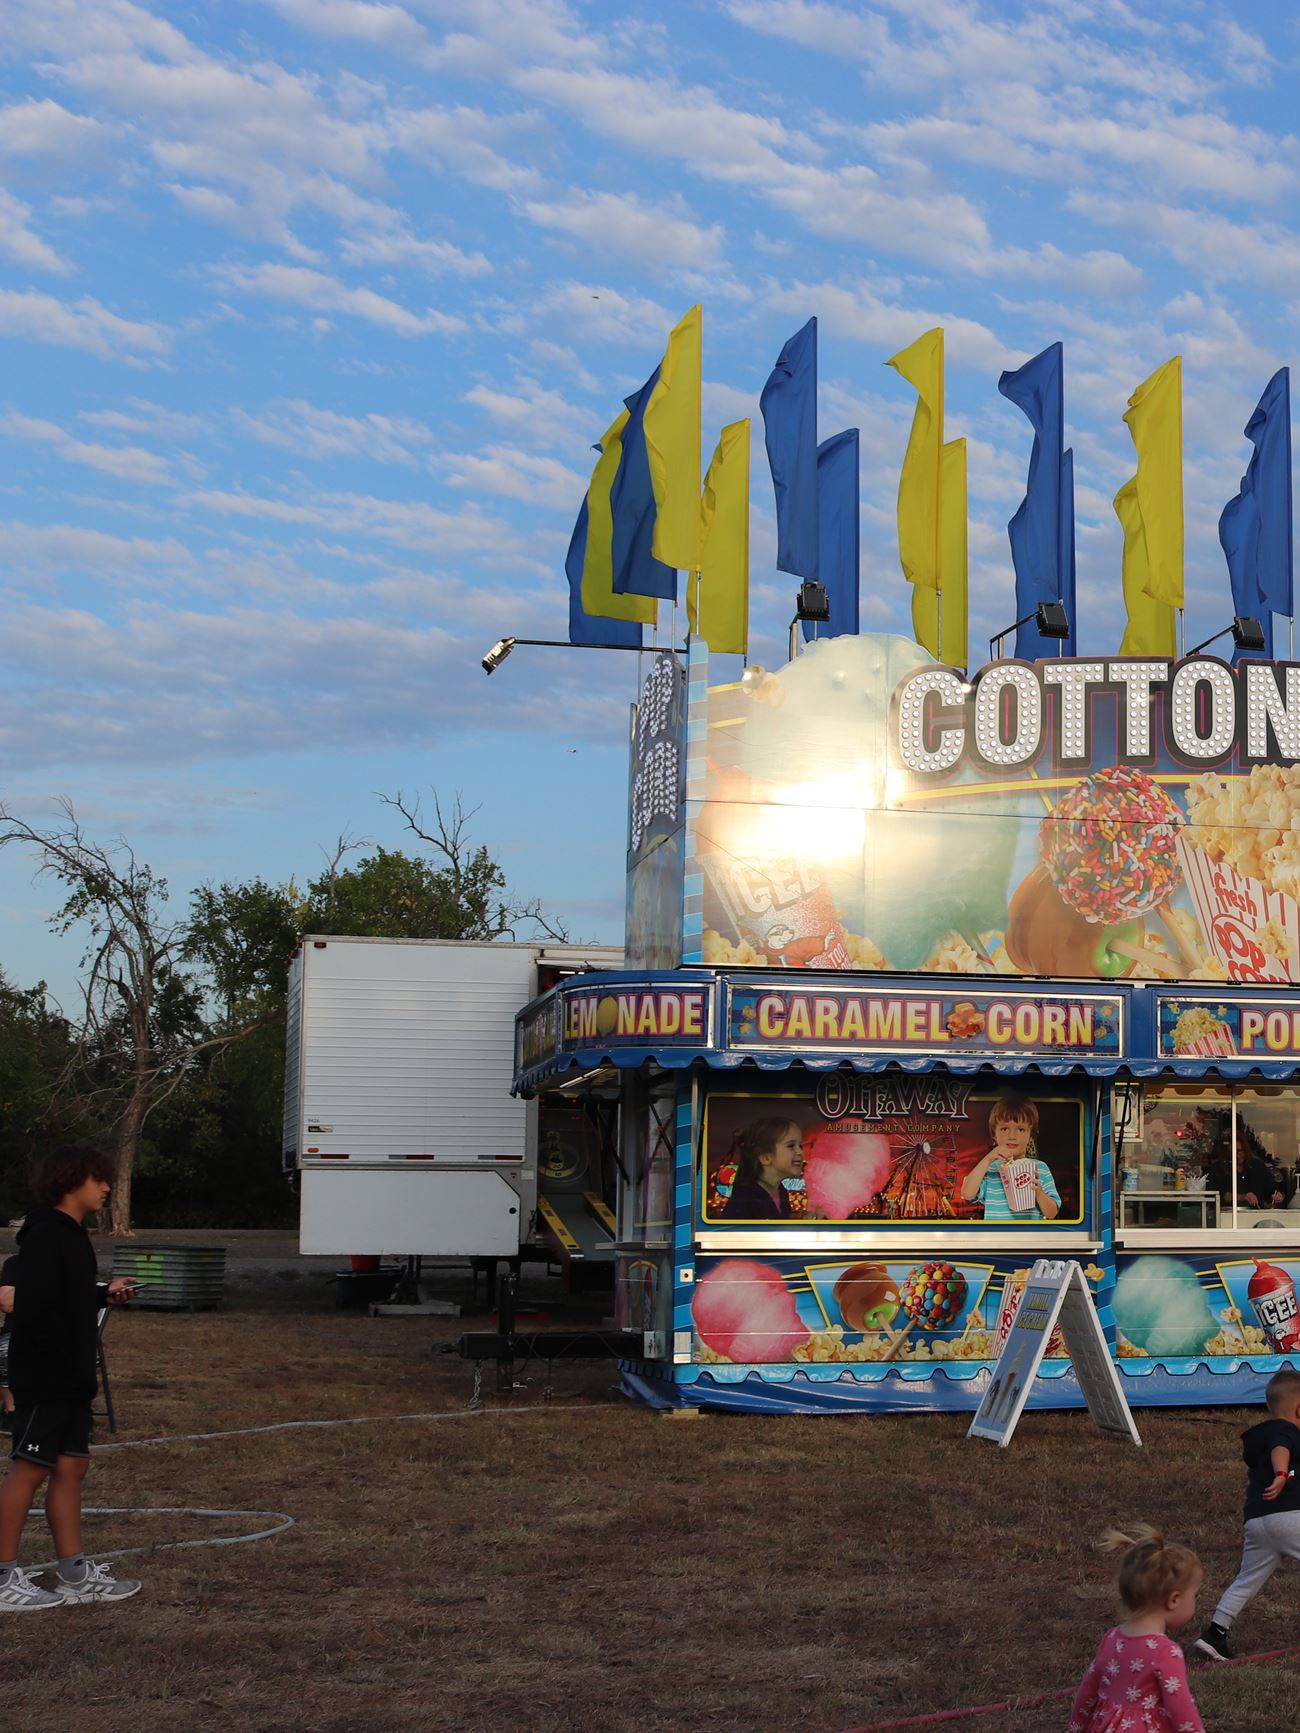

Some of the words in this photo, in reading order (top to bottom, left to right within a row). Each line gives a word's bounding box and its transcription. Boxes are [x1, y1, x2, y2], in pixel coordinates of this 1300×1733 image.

[1213, 871, 1257, 917] fresh
[1213, 921, 1267, 969] POP
[1227, 960, 1288, 982] CO
[758, 996, 951, 1043] CARAMEL
[986, 1001, 1094, 1047] CORN
[815, 1072, 977, 1121] OTTAWAY
[825, 1122, 899, 1133] AMUSEMENT
[906, 1122, 962, 1133] COMPANY
[1256, 1290, 1297, 1326] ICEE
